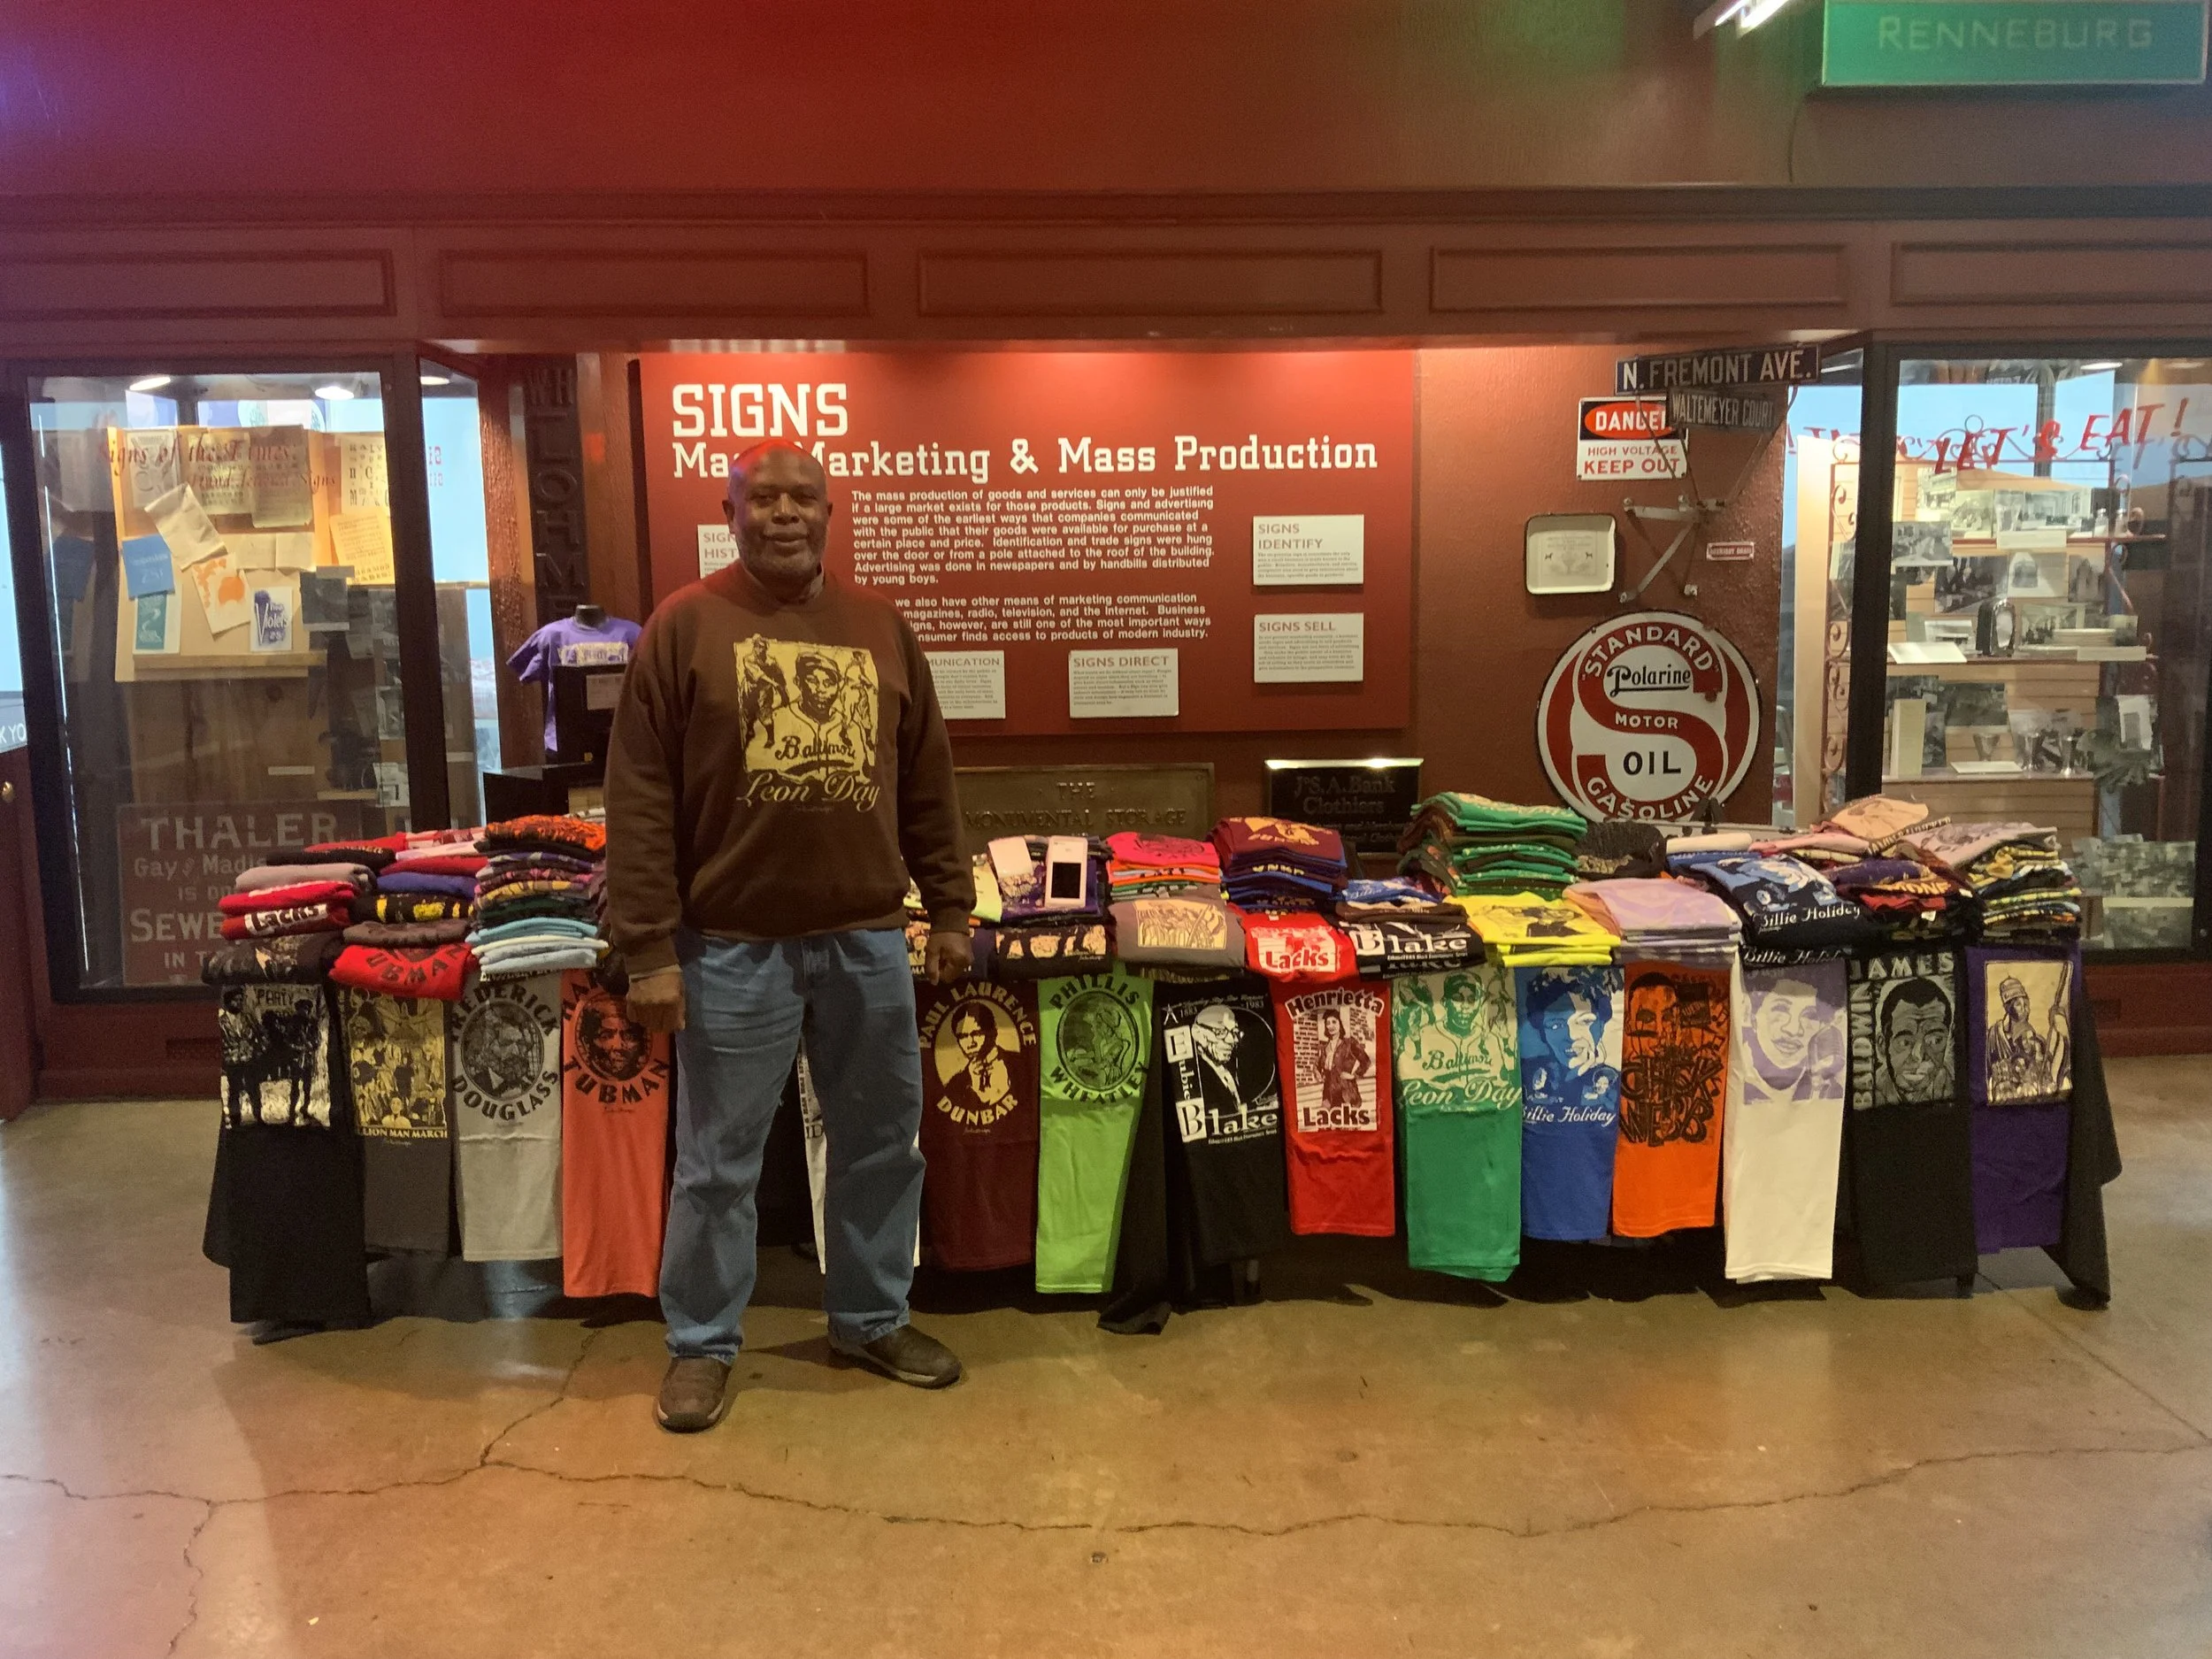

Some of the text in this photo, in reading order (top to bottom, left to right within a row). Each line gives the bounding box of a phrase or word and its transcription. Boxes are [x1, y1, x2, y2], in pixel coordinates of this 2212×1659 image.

[1878, 15, 2154, 51] RENNEBURG
[1623, 349, 1811, 390] N. FREMONT AVE.
[672, 383, 849, 437] SIGNS
[1742, 399, 1775, 427] COURT
[1595, 410, 1667, 432] DANGE
[672, 442, 740, 479] Ma
[1009, 438, 1039, 473] &
[1058, 437, 1156, 473] Mass
[1174, 434, 1378, 472] Production
[1587, 445, 1678, 457] HIGH VOLTAGE
[1584, 457, 1680, 474] KEEP OUT
[910, 489, 967, 502] production
[987, 488, 1021, 501] goods
[1050, 488, 1095, 498] services
[1170, 486, 1213, 499] justified
[874, 498, 1213, 515] large market exists those products. Signs advertising
[956, 513, 995, 524] earliest
[1000, 515, 1027, 526] ways
[1057, 511, 1116, 525] companies
[1120, 511, 1198, 522] communicated
[1257, 523, 1301, 534] SIGNS
[703, 533, 736, 542] SIGN
[902, 526, 933, 539] public
[993, 525, 1026, 537] goods
[1062, 524, 1108, 534] available
[1133, 523, 1181, 535] purchase
[853, 538, 891, 549] certain
[895, 538, 925, 550] place
[954, 537, 984, 549] price.
[993, 536, 1062, 547] Identification
[1091, 535, 1118, 546] trade
[1124, 535, 1152, 548] signs
[1018, 546, 1214, 558] attached building.
[1257, 538, 1323, 549] IDENTIFY
[855, 557, 1209, 574] Advertising done newspapers handbills distributed
[872, 573, 938, 586] young boys.
[971, 595, 999, 606] other
[1058, 595, 1111, 607] marketing
[1117, 593, 1196, 604] communication
[902, 608, 963, 621] magazines,
[967, 608, 997, 620] radio,
[1002, 607, 1055, 619] television,
[1157, 605, 1205, 616] Business
[939, 618, 1210, 633] however, most important ways
[961, 632, 987, 641] finds
[993, 633, 1030, 641] access
[1050, 630, 1098, 643] products
[1118, 629, 1158, 640] modern
[1163, 628, 1208, 641] industry.
[1258, 621, 1336, 633] SIGNS SELL
[1073, 656, 1170, 668] SIGNS DIRECT
[1607, 664, 1692, 696] Polarine
[1615, 711, 1678, 729] MOTOR
[1623, 750, 1681, 775] OIL
[736, 771, 880, 813] Leon Day
[1055, 781, 1096, 800] THE
[1348, 775, 1396, 795] Bank
[1302, 795, 1385, 815] Clothiers
[1586, 775, 1714, 819] GASOLINE
[1106, 807, 1187, 826] STORAGE
[140, 812, 338, 851] THALER
[134, 857, 177, 881] Gay
[1358, 931, 1468, 954] Blake
[164, 951, 186, 969] IN
[1266, 949, 1329, 969] Lacks
[1049, 973, 1141, 1010] PHILLIS
[1287, 988, 1383, 1018] Henrietta
[919, 981, 1037, 1048] PAUL LAURENCE
[563, 1055, 670, 1104] TUBMAN
[1050, 1062, 1149, 1104] WHEATLEY
[452, 1070, 559, 1120] DOUGLASS
[1402, 1077, 1523, 1110] Leon Day
[936, 1093, 1018, 1125] DUNBAR
[1302, 1105, 1371, 1127] Lacks
[1558, 1105, 1617, 1128] Holiday
[1180, 1102, 1279, 1139] Blake
[389, 1127, 411, 1137] MAN
[411, 1128, 448, 1138] MARCH
